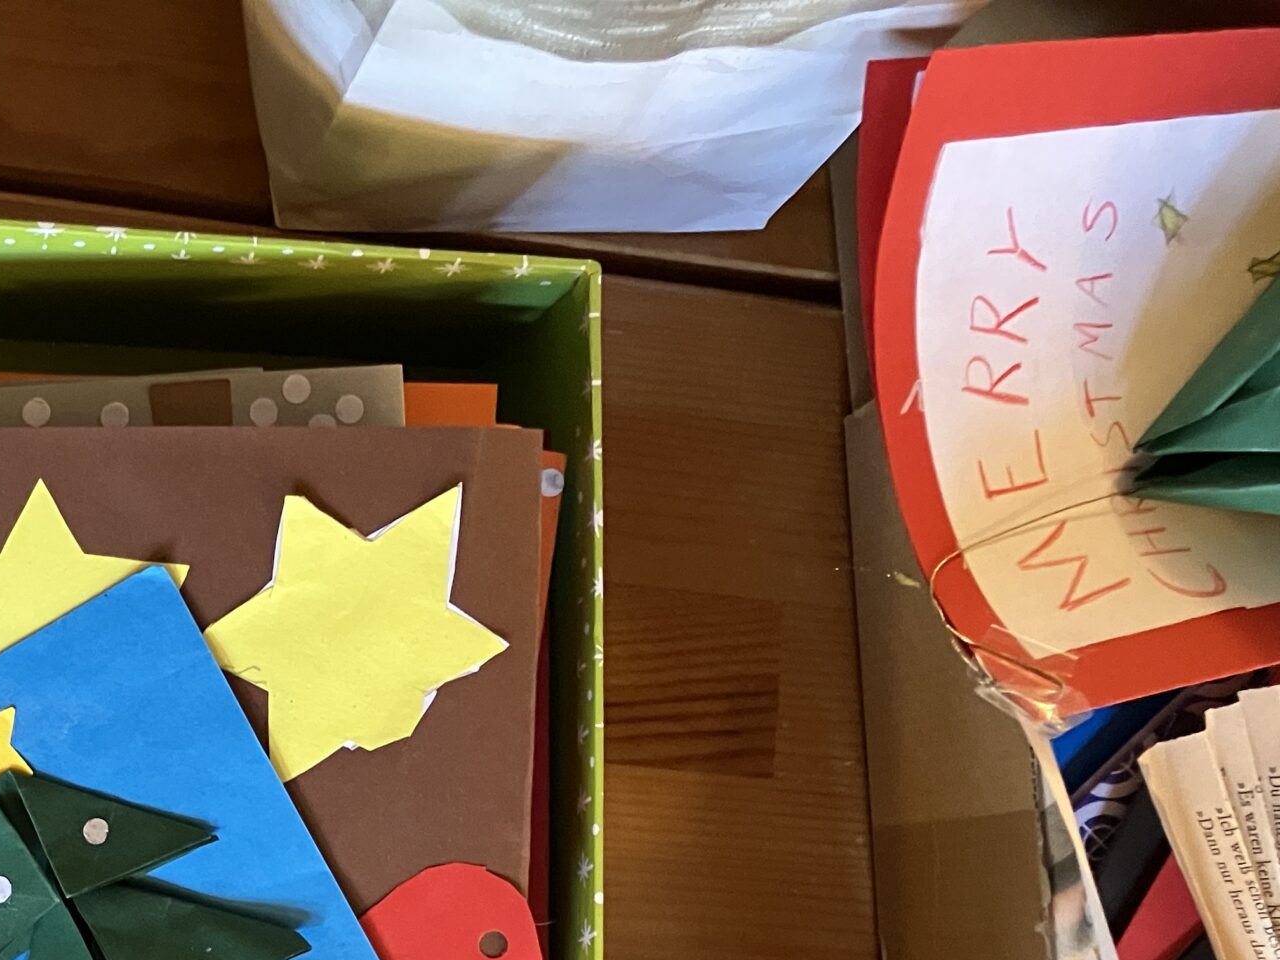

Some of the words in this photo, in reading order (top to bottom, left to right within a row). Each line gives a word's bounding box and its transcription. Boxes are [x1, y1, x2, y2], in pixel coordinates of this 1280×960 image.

[962, 206, 1131, 612] MERRY
[1073, 199, 1228, 599] CHRISTMAS
[1218, 861, 1235, 885] nur
[1229, 889, 1255, 935] heraus
[1244, 811, 1263, 855] waren
[1256, 860, 1274, 898] keine
